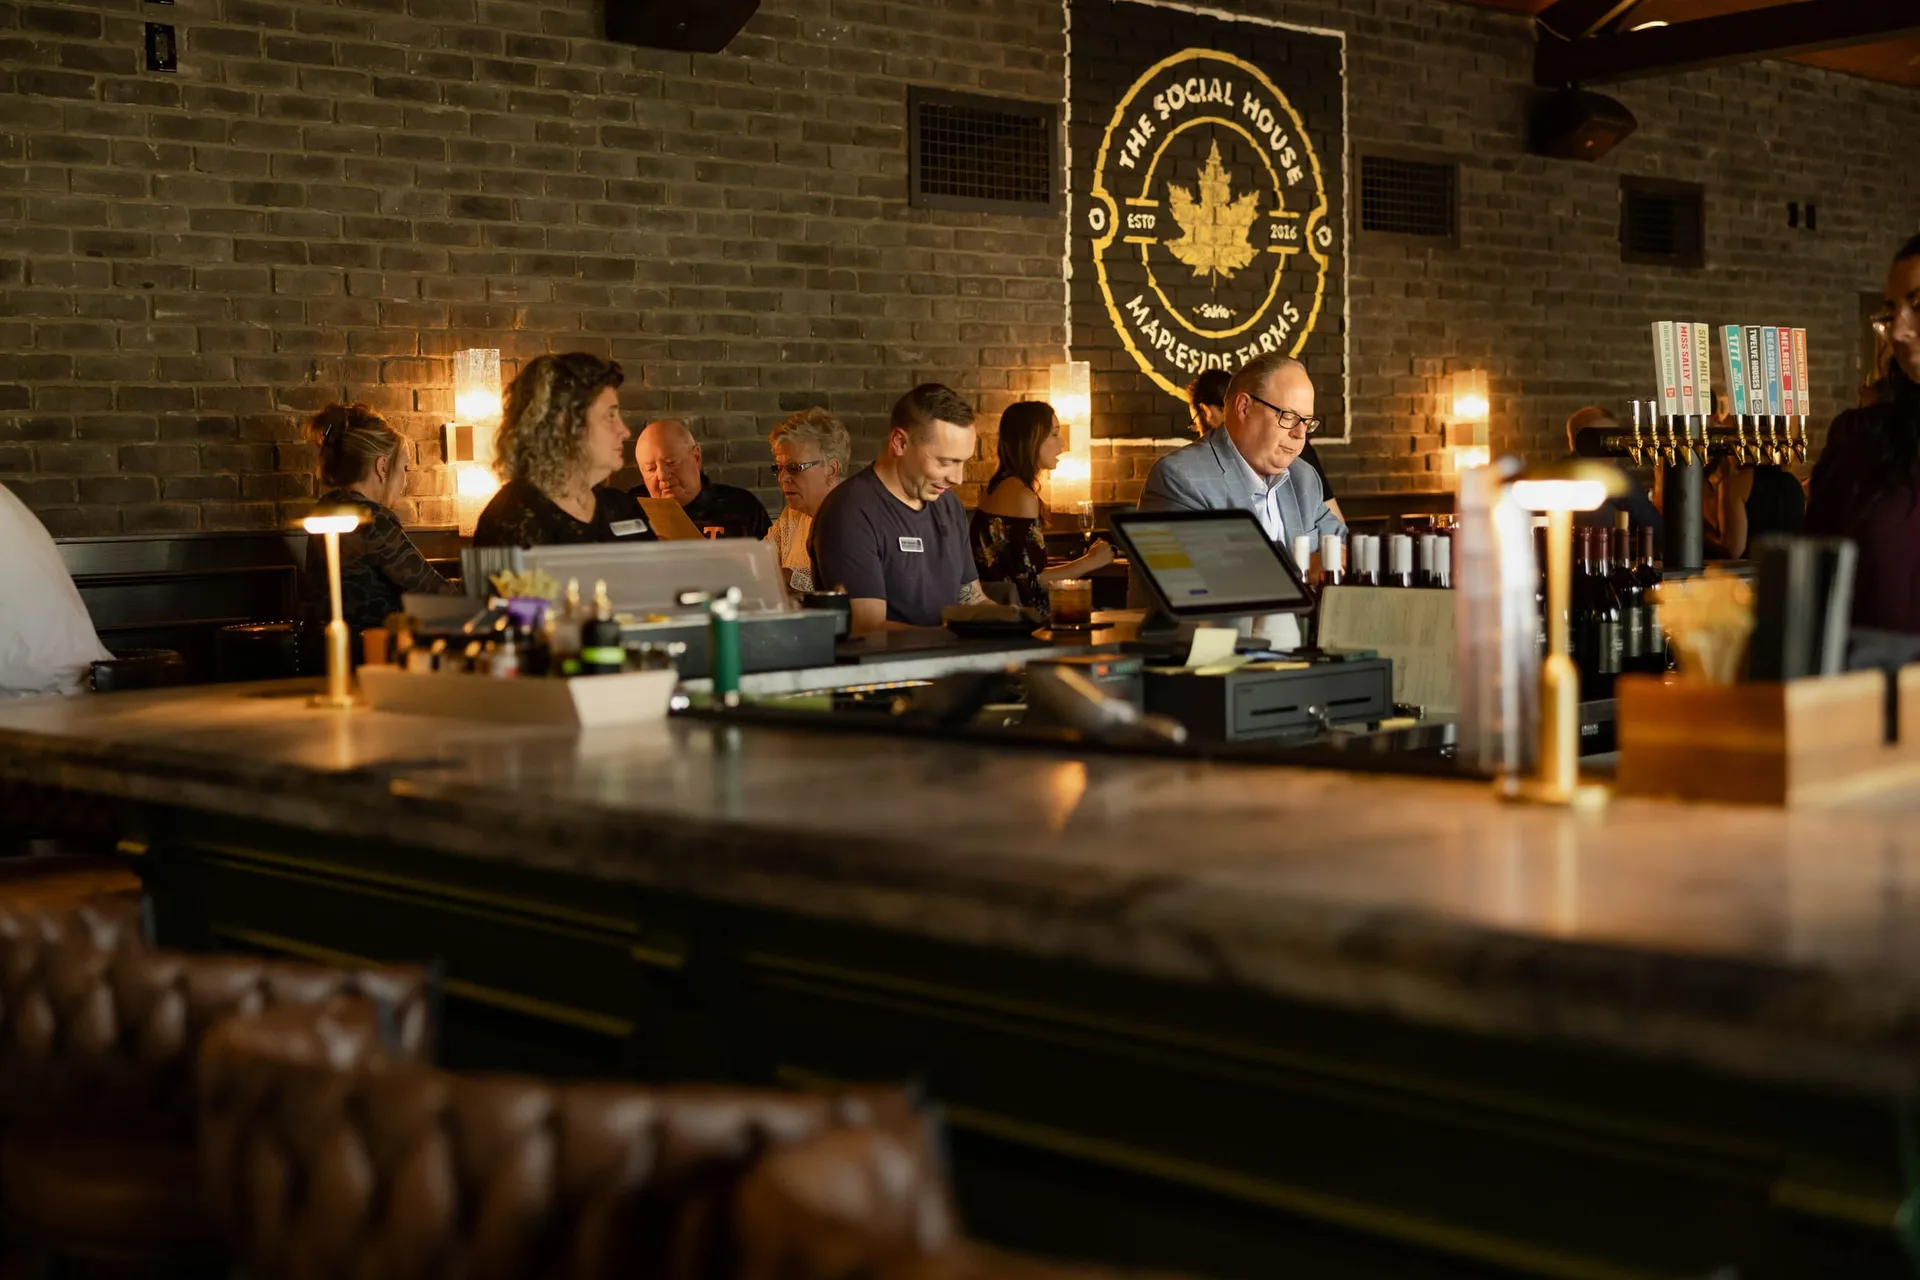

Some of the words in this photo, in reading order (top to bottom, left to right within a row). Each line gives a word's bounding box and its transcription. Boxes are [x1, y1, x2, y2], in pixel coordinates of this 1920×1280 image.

[1119, 113, 1156, 169] THE
[1153, 77, 1235, 121] SOCIAL
[1242, 91, 1304, 186] HOUSE
[1126, 213, 1156, 230] ESTD
[1269, 224, 1298, 240] 2016
[1125, 294, 1233, 375] MAPLESIDE
[1235, 300, 1300, 367] FARMS
[1680, 325, 1688, 350] MISS
[1698, 329, 1707, 359] SIXTY
[1728, 333, 1741, 362] 1777
[1749, 328, 1759, 360] TWELVE
[1681, 351, 1691, 380] SALLY
[1766, 331, 1776, 384] SEASONAL
[1780, 331, 1791, 377] MELROSE
[1699, 360, 1709, 385] MILE
[1751, 360, 1760, 389] HOUSES
